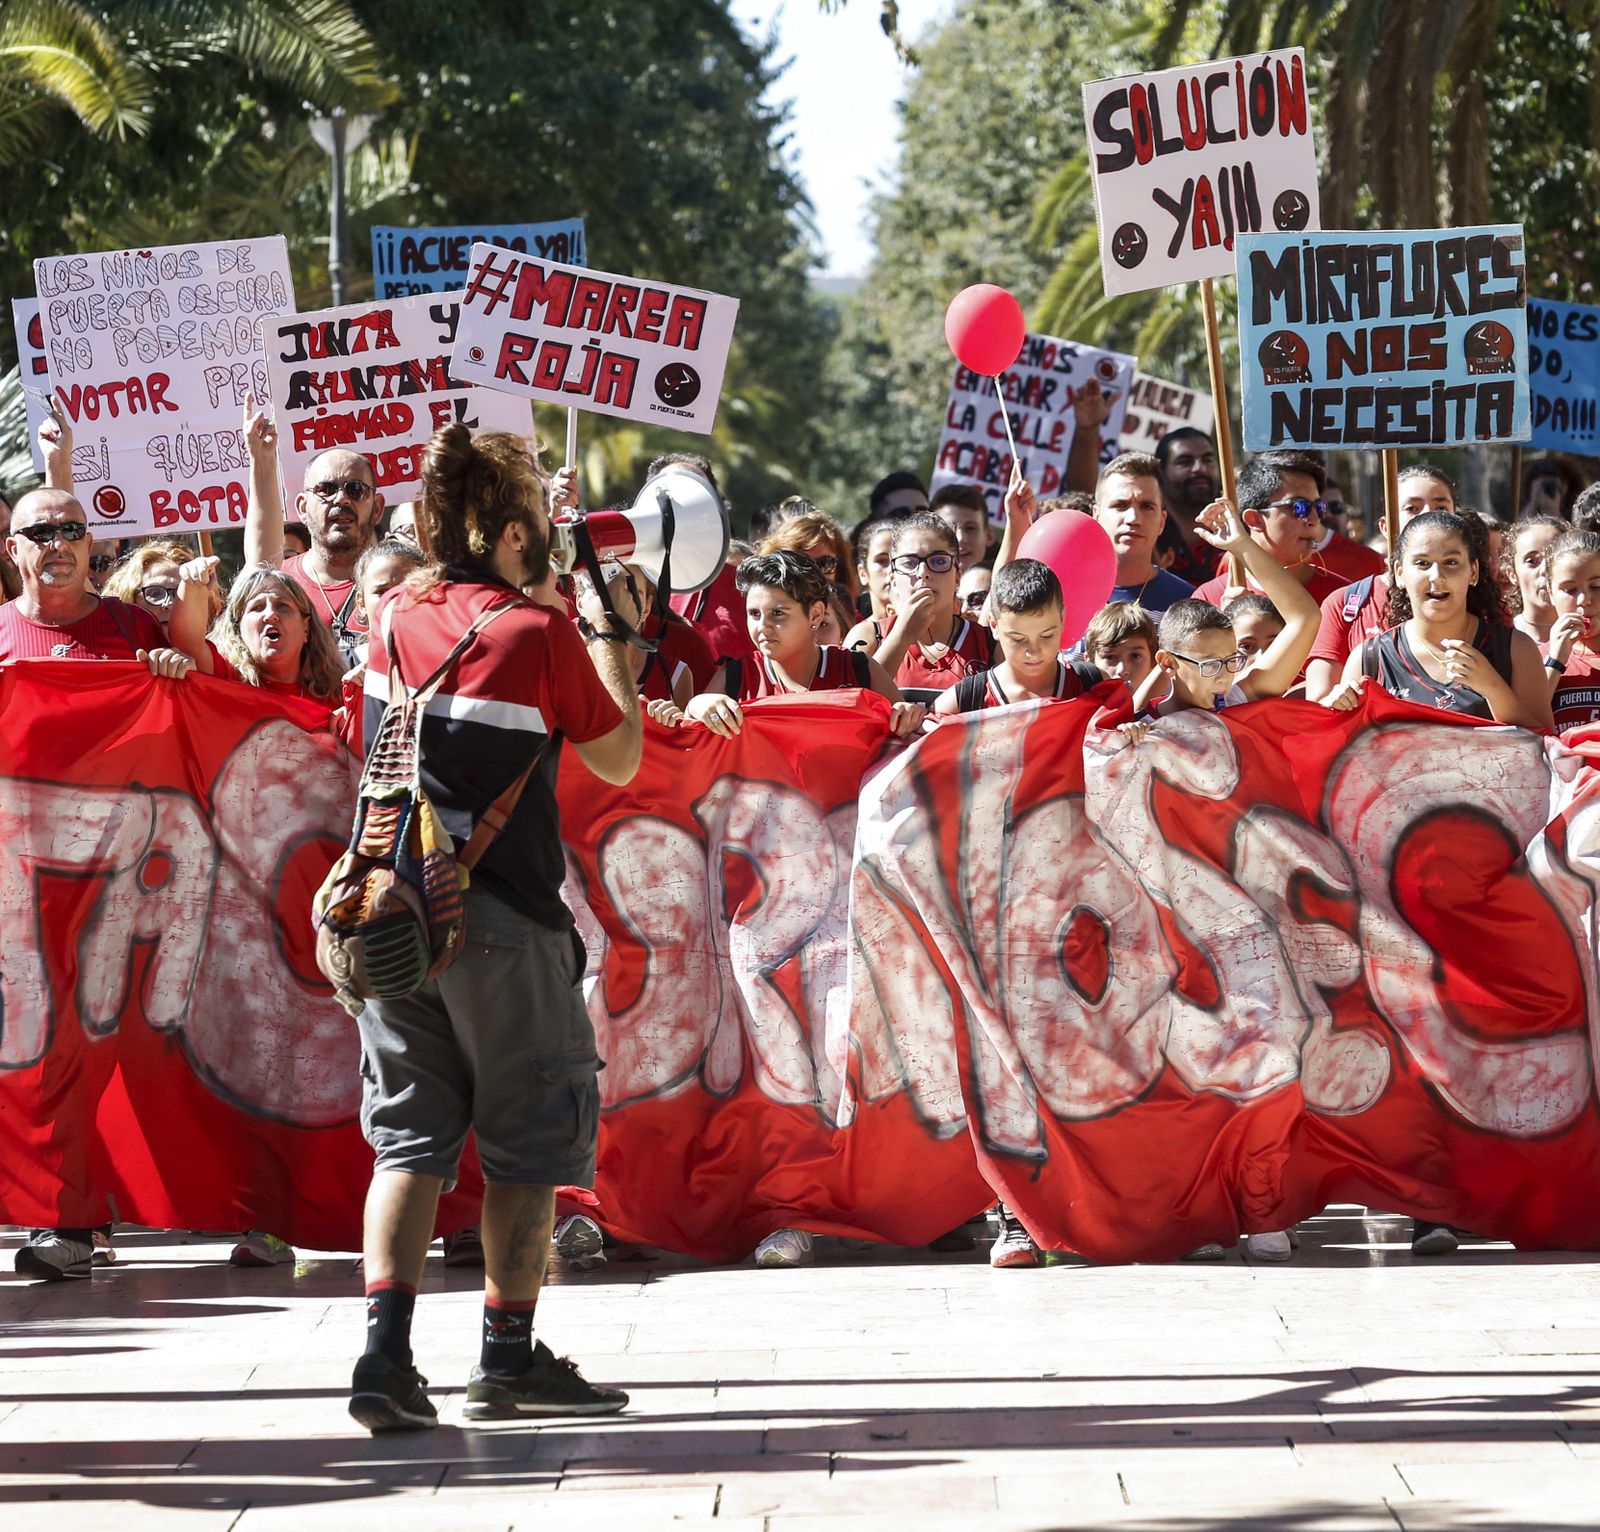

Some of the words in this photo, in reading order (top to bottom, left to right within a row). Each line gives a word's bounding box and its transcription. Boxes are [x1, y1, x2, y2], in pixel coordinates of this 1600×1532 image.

[1093, 54, 1307, 174] SOLUCIÓN
[39, 257, 95, 298] LOS
[102, 250, 203, 292] NIÑOS
[216, 245, 256, 275] DE
[462, 251, 708, 352] #MAREA
[1249, 234, 1526, 326] MIRAFLORES
[49, 288, 171, 335] PUERTA
[178, 271, 288, 316] OSCURA
[277, 310, 401, 364] JUNTA
[429, 302, 460, 344] Y
[51, 337, 93, 377] NO
[494, 331, 640, 410] ROJA
[1326, 321, 1449, 381] NOS
[55, 371, 180, 423] VOTAR
[203, 360, 270, 409] PER
[1269, 379, 1516, 447] NECESITA
[291, 402, 415, 453] FIRMAD
[428, 397, 479, 432] EL
[947, 400, 977, 432] LA
[986, 410, 1067, 453] CALLE
[72, 436, 110, 483] SI
[149, 481, 249, 529] BOTA
[1560, 691, 1592, 707] PUERTA
